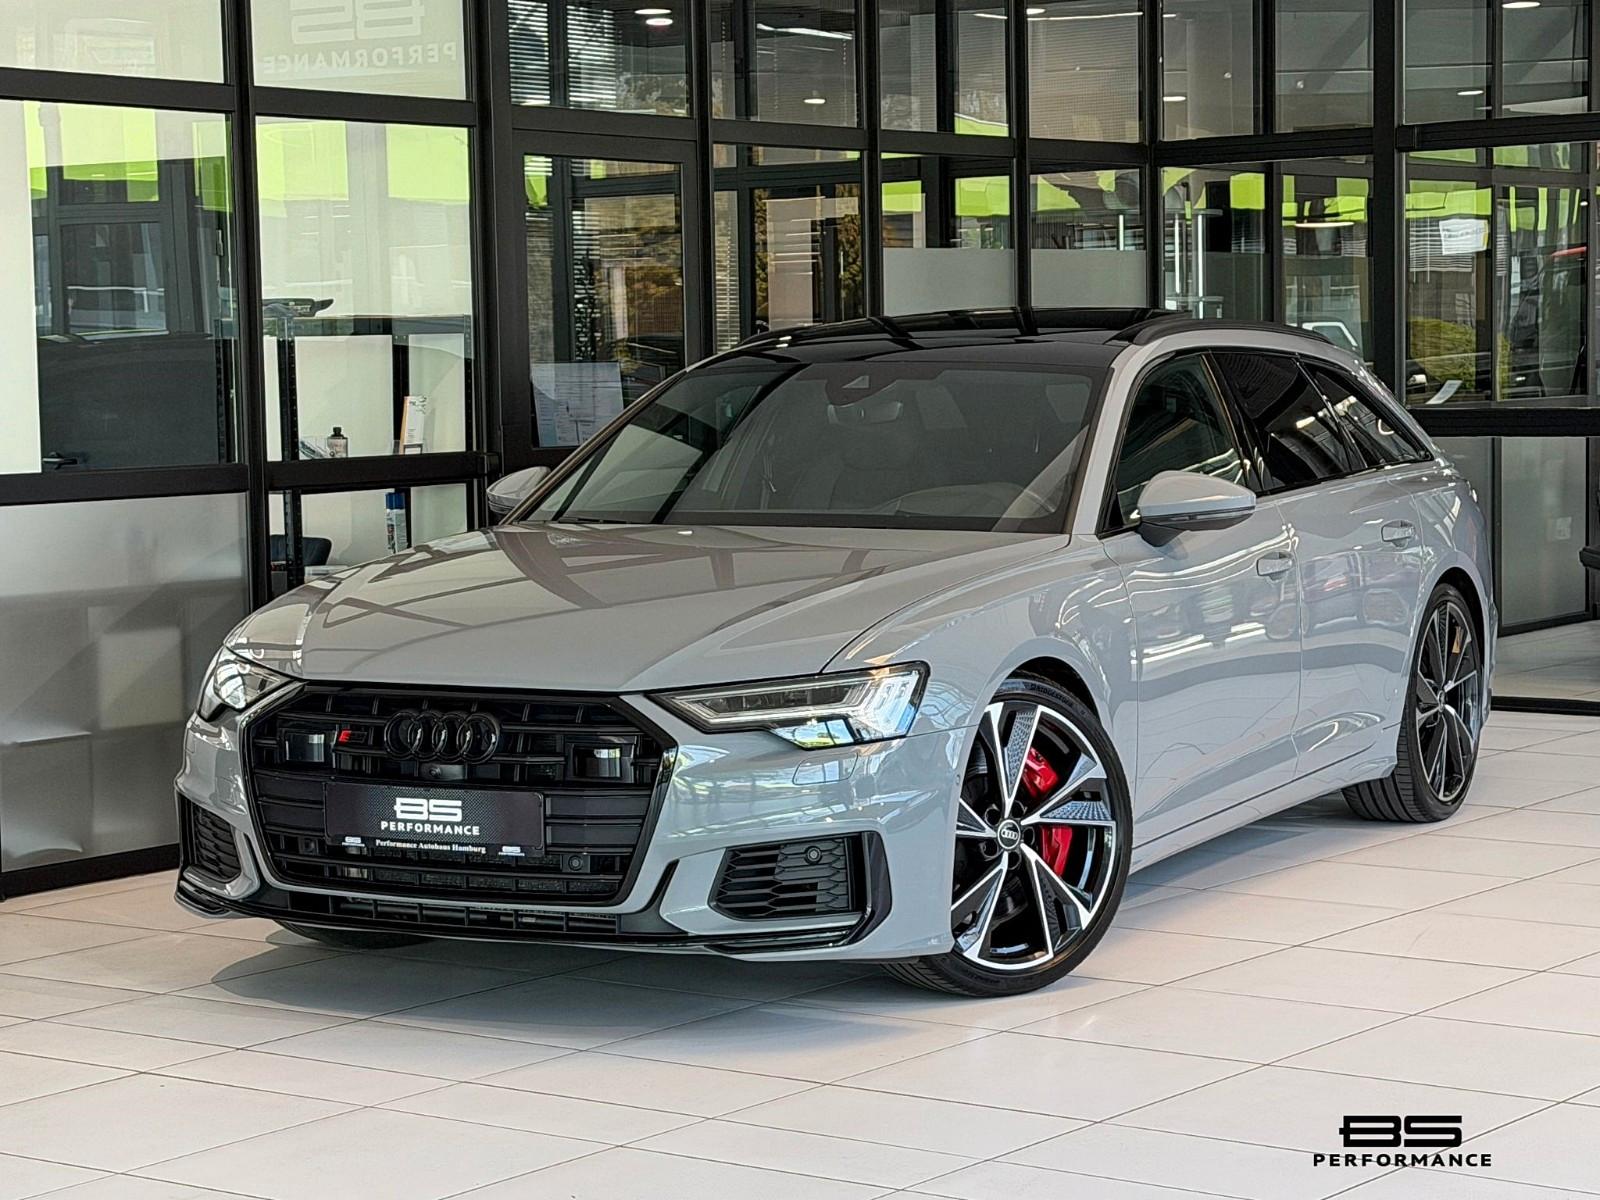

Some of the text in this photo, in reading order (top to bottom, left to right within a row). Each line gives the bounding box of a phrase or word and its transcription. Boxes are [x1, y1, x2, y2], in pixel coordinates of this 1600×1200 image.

[394, 797, 462, 822] BS
[380, 821, 480, 836] PERFORMANCE
[375, 839, 418, 849] Performance
[418, 842, 451, 851] Autohaus
[452, 844, 486, 854] Hamburg
